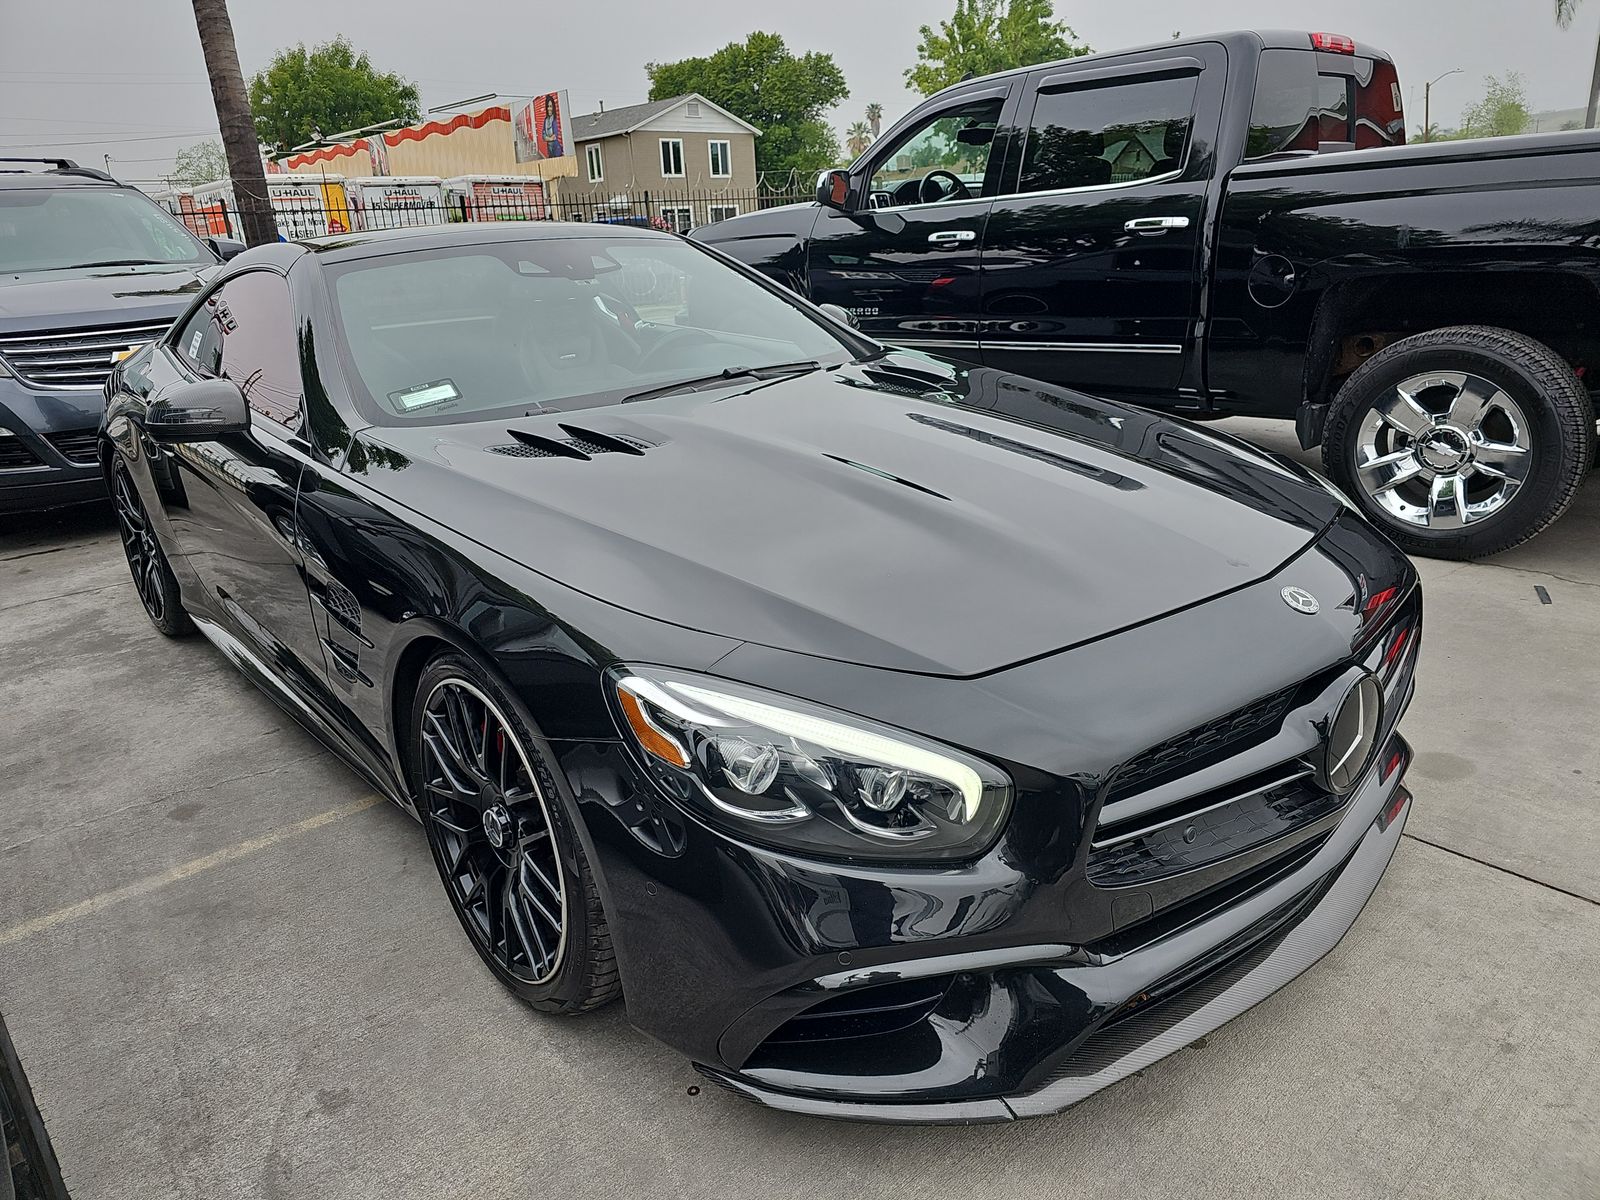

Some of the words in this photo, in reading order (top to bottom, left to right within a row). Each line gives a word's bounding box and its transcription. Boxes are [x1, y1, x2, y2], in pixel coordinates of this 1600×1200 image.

[272, 189, 314, 197] U-HAUL
[384, 189, 420, 197] U-HAUL
[290, 229, 315, 239] EASIER
